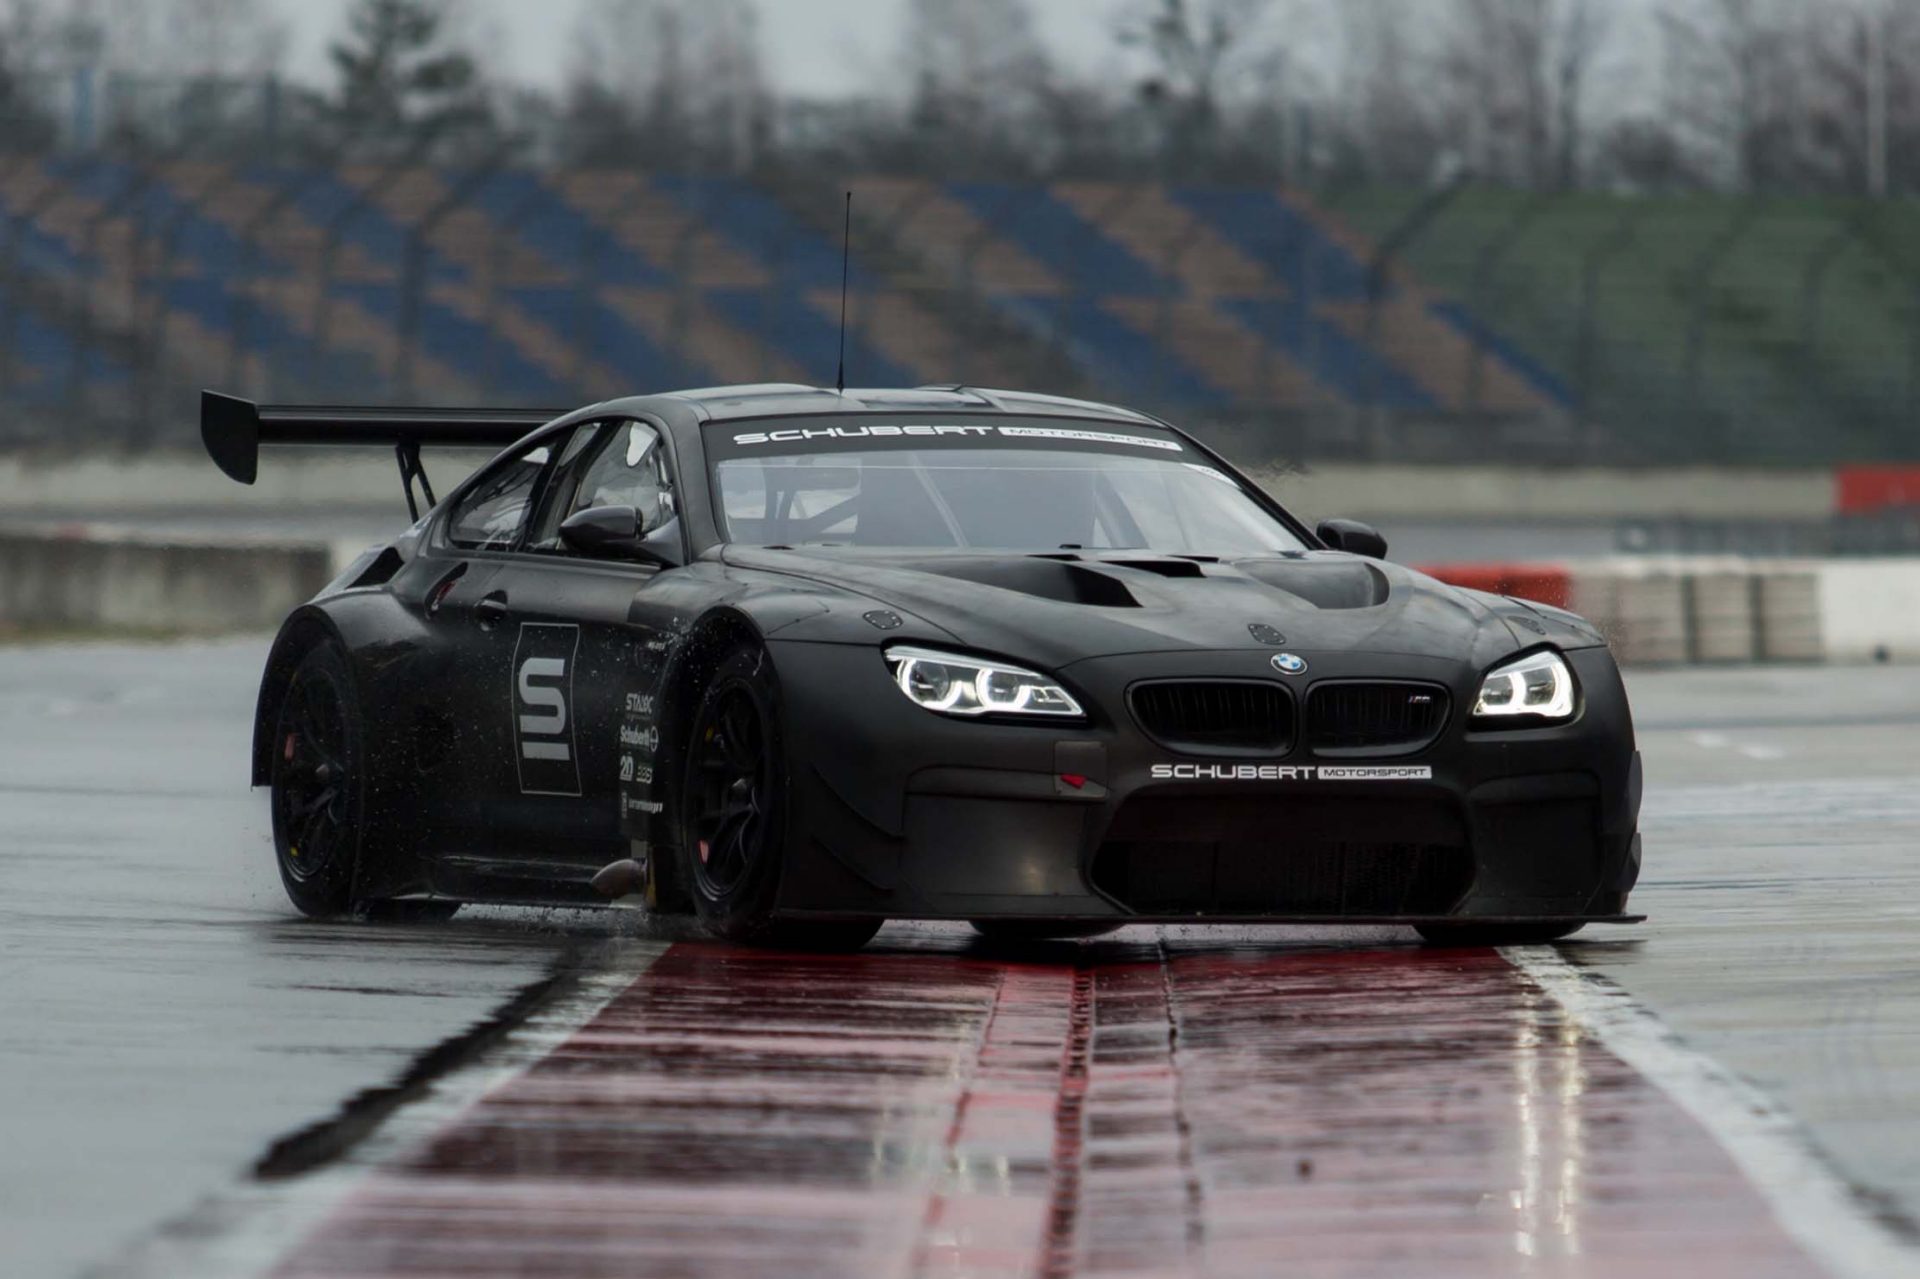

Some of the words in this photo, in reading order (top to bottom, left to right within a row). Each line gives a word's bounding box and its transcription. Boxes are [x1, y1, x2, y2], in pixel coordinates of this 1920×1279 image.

[733, 425, 993, 445] SCHUBERT
[1008, 428, 1169, 447] MOTORSPORT
[1151, 764, 1316, 779] SCHUBERT
[1322, 767, 1430, 777] MOTORSPORT
